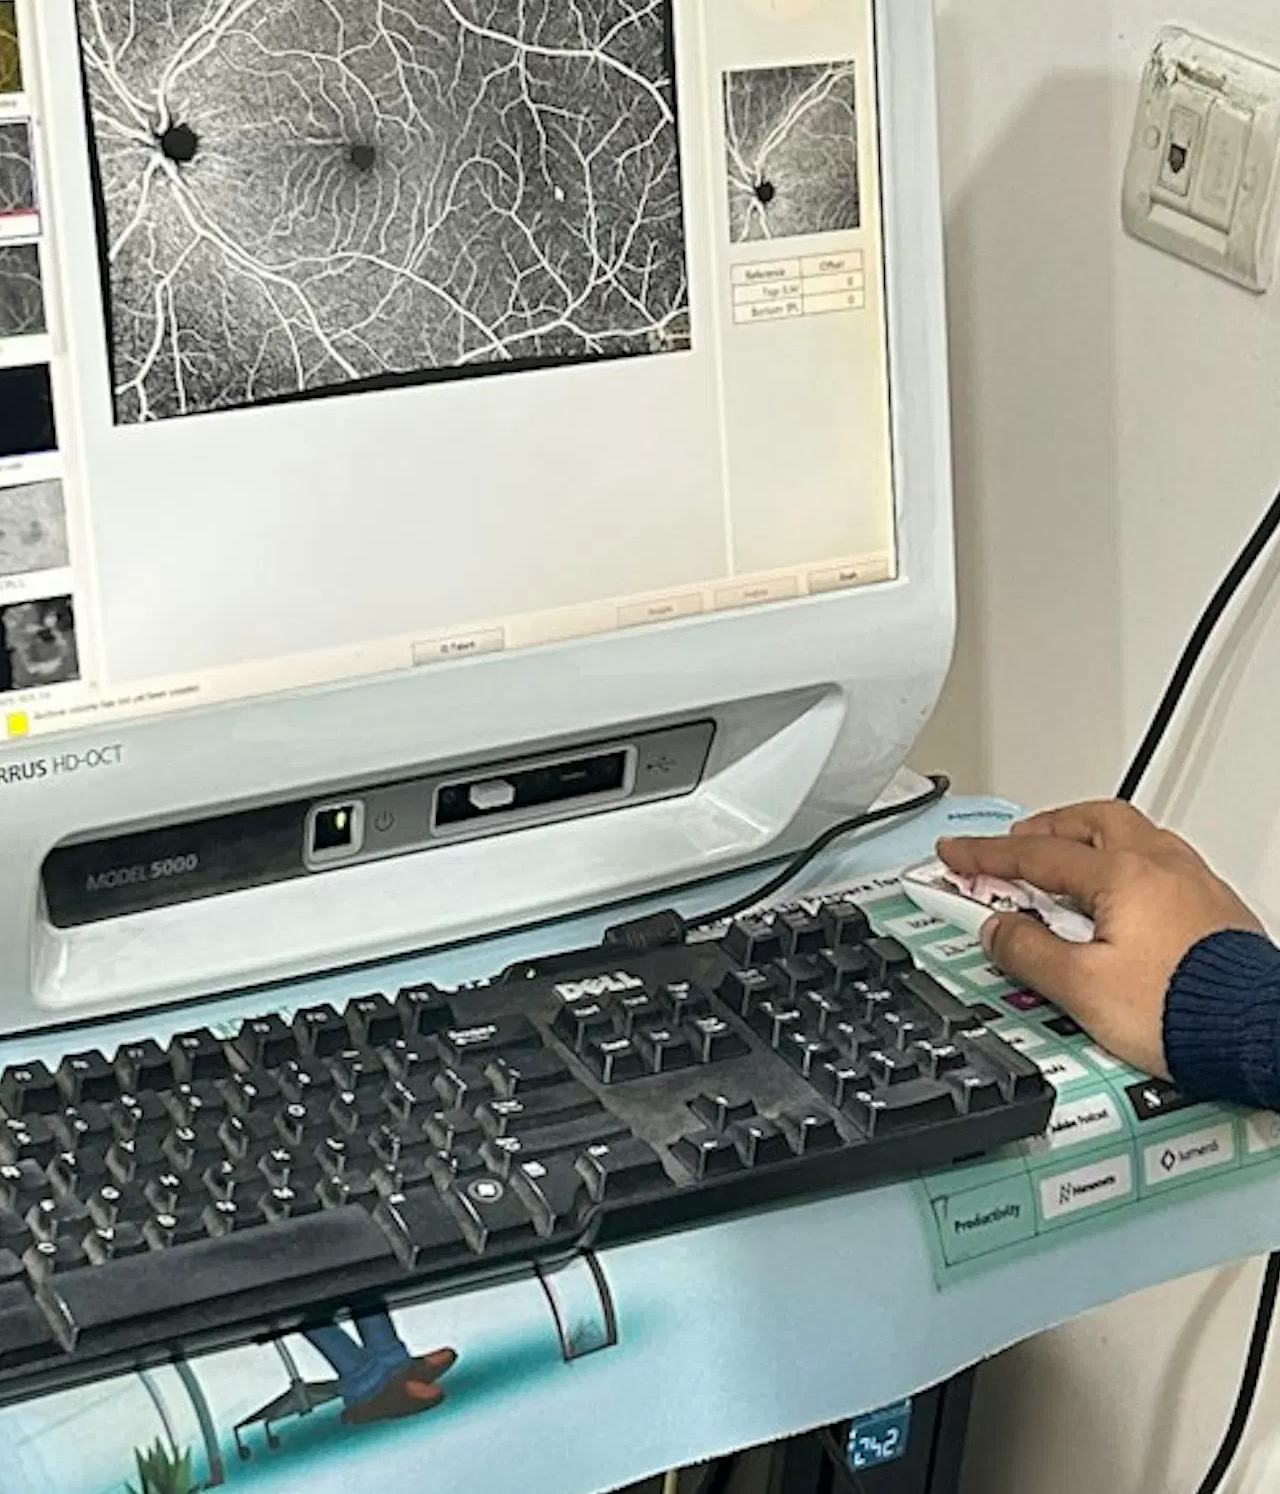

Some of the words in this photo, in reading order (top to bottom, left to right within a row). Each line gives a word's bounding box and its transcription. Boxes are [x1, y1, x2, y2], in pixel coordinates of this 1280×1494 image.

[52, 744, 123, 775] HD-OCT
[85, 864, 148, 892] MODEL
[150, 852, 199, 879] 5000
[554, 970, 644, 1002] DELL
[954, 1204, 1020, 1234] Productivity
